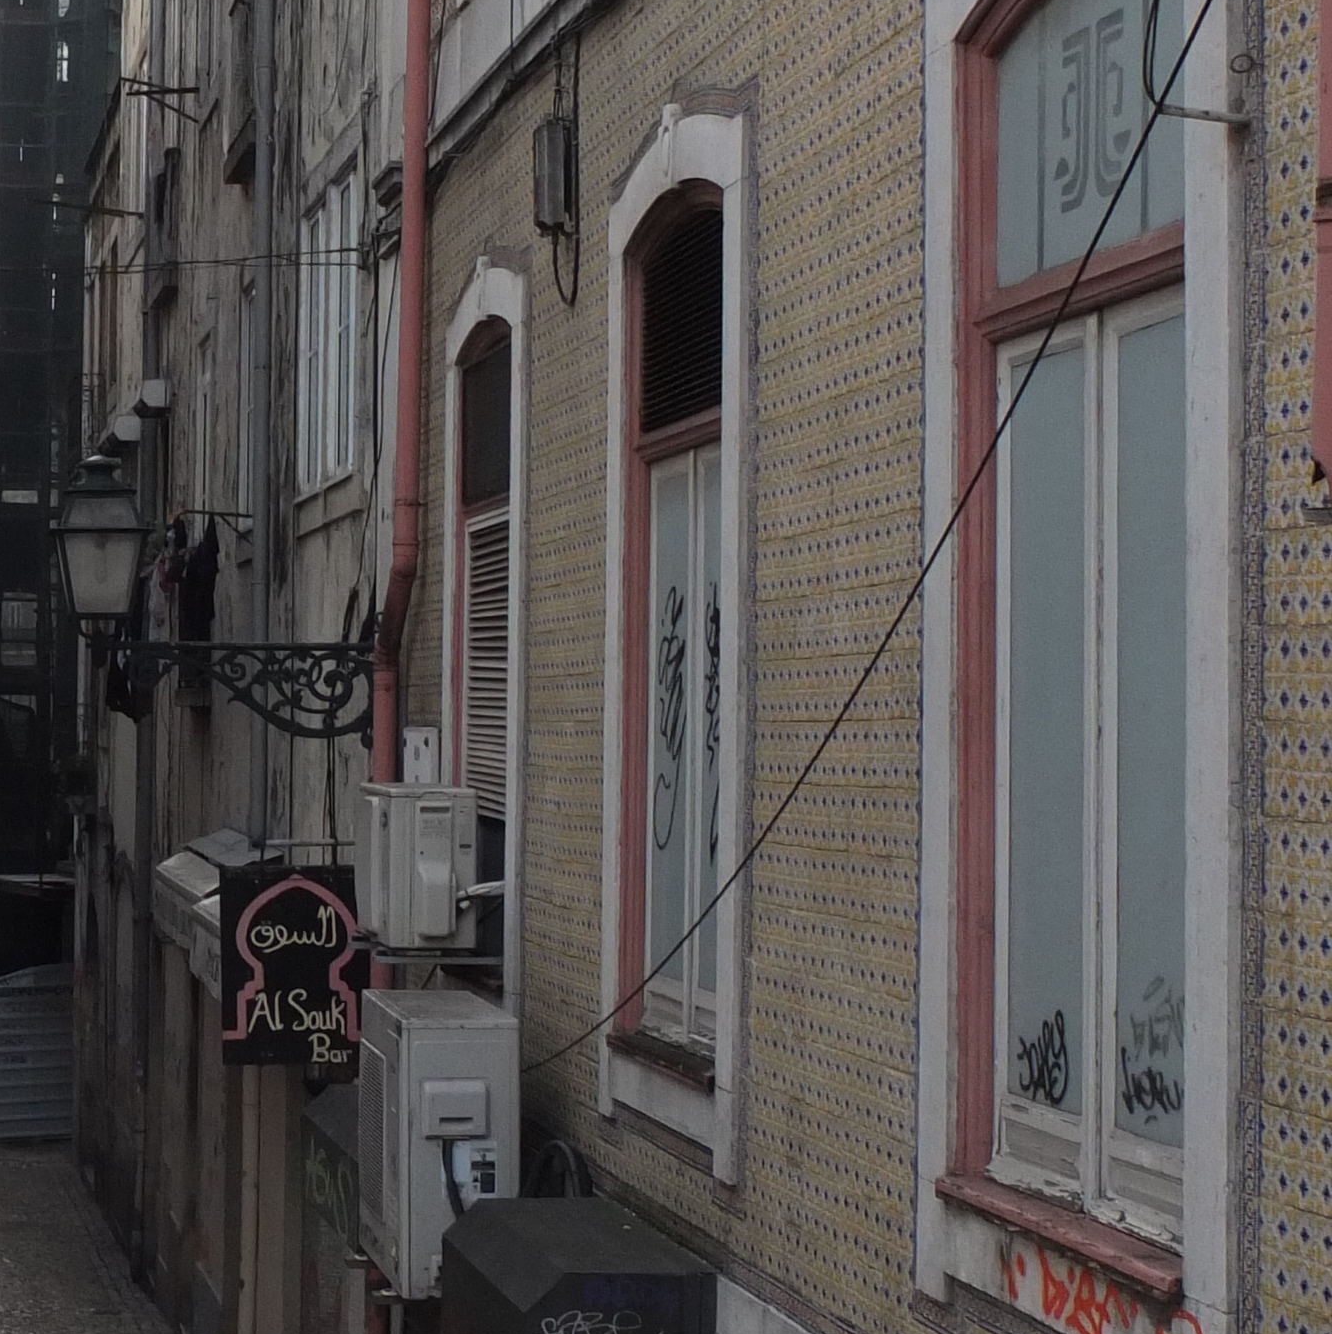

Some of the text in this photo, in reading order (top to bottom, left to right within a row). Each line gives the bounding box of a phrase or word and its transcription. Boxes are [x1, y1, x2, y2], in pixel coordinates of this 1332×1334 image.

[249, 989, 346, 1033] Al Souk
[308, 1033, 352, 1063] Bar
